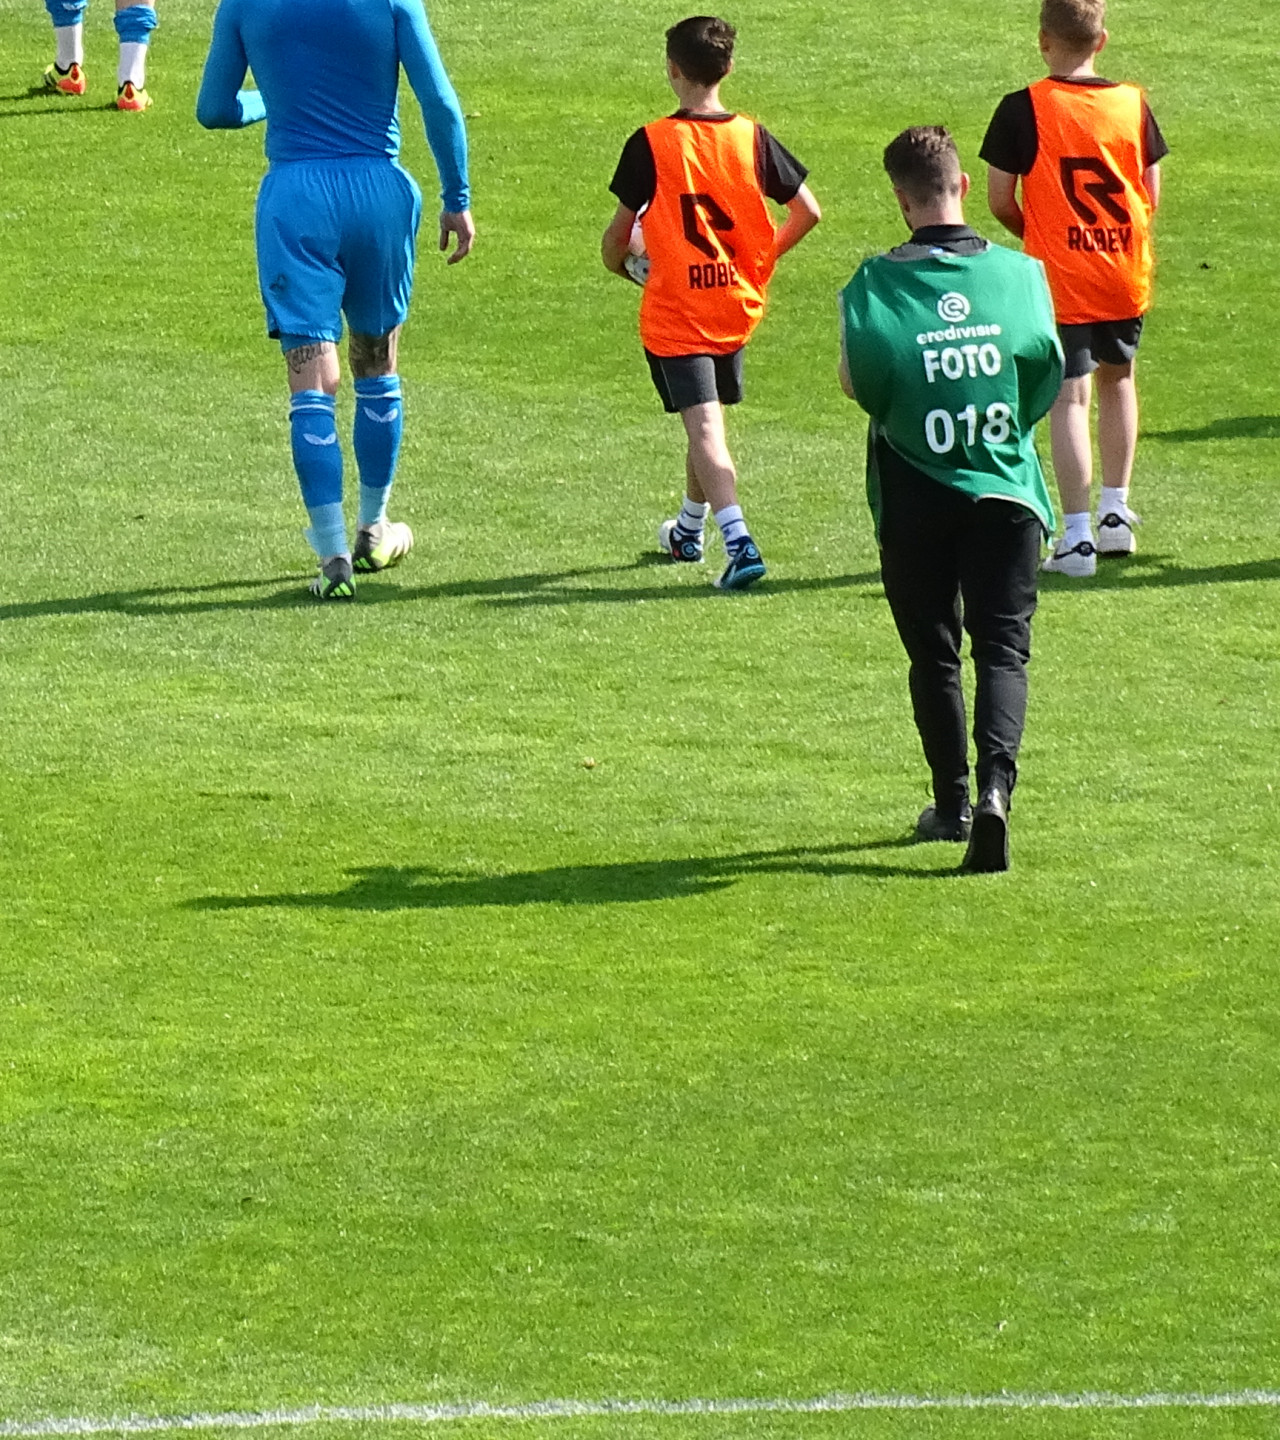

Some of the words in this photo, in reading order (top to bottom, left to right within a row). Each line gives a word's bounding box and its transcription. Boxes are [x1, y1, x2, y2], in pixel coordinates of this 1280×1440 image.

[1067, 226, 1134, 253] ROBEY
[688, 262, 739, 290] ROBE
[916, 323, 1002, 345] eredivisie
[922, 342, 1002, 384] FOTO
[924, 402, 1011, 454] 018
